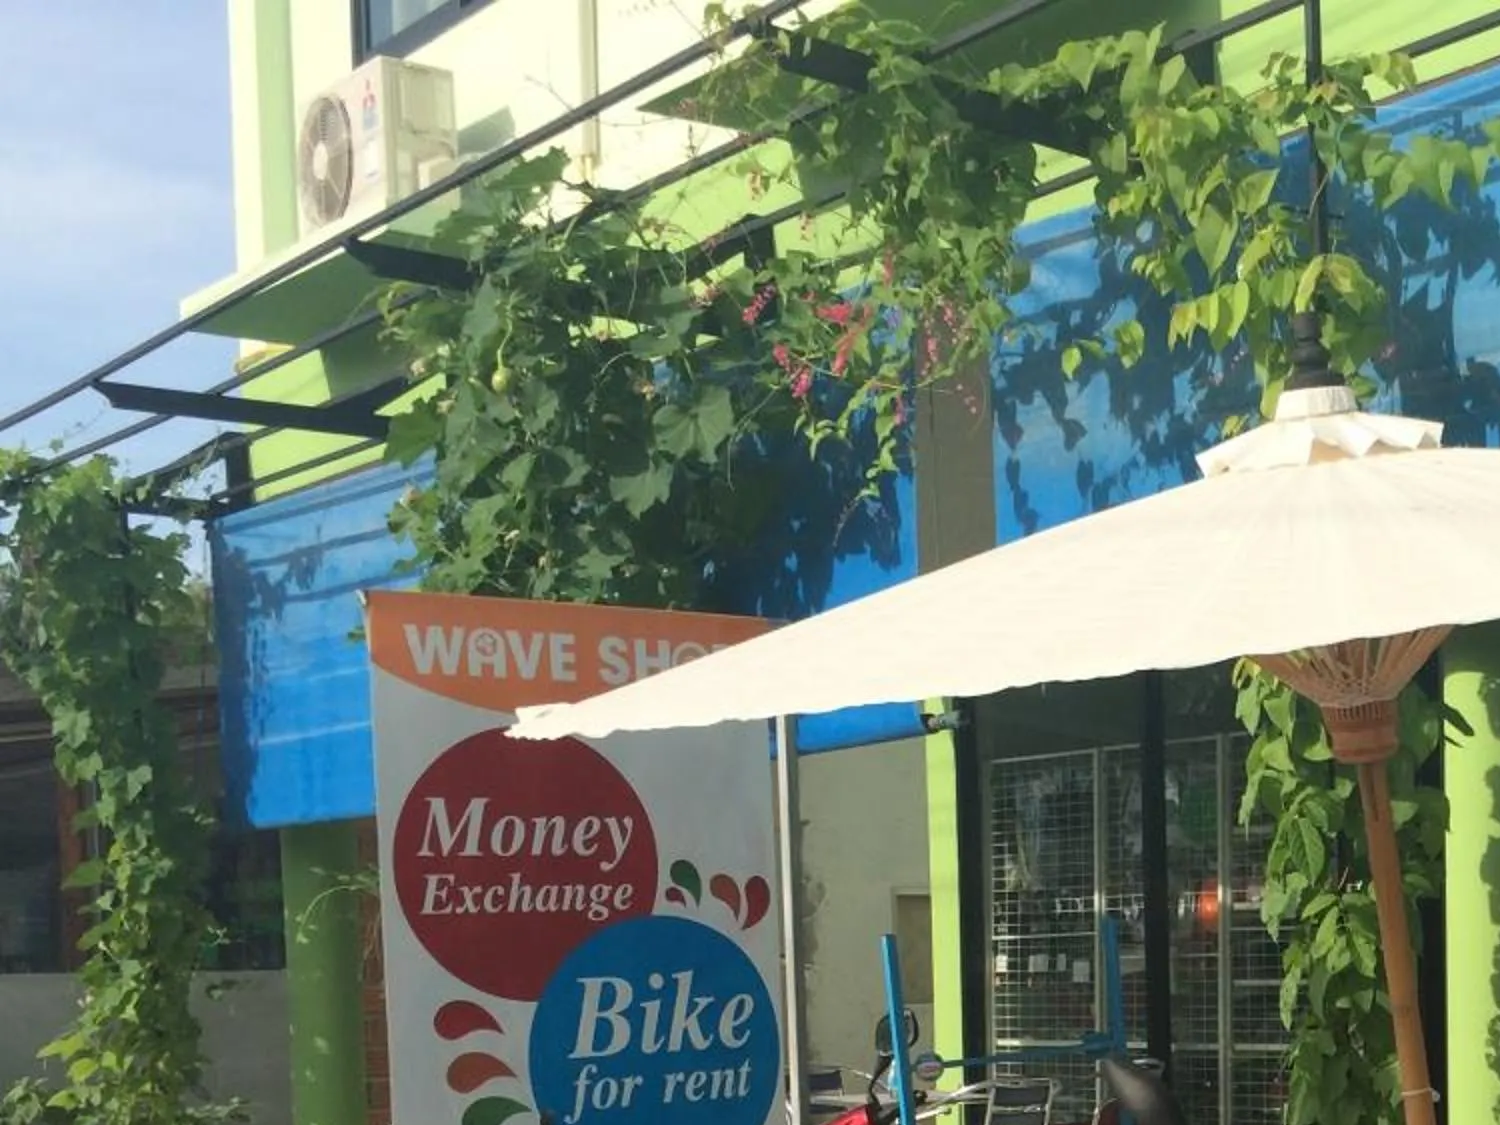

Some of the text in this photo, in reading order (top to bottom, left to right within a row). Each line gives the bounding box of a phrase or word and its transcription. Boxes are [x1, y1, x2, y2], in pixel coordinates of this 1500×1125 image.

[403, 623, 578, 682] WAVE
[417, 797, 633, 872] Money
[421, 873, 633, 921] Exchange
[568, 972, 755, 1060] Bike
[565, 1060, 752, 1125] for rent
